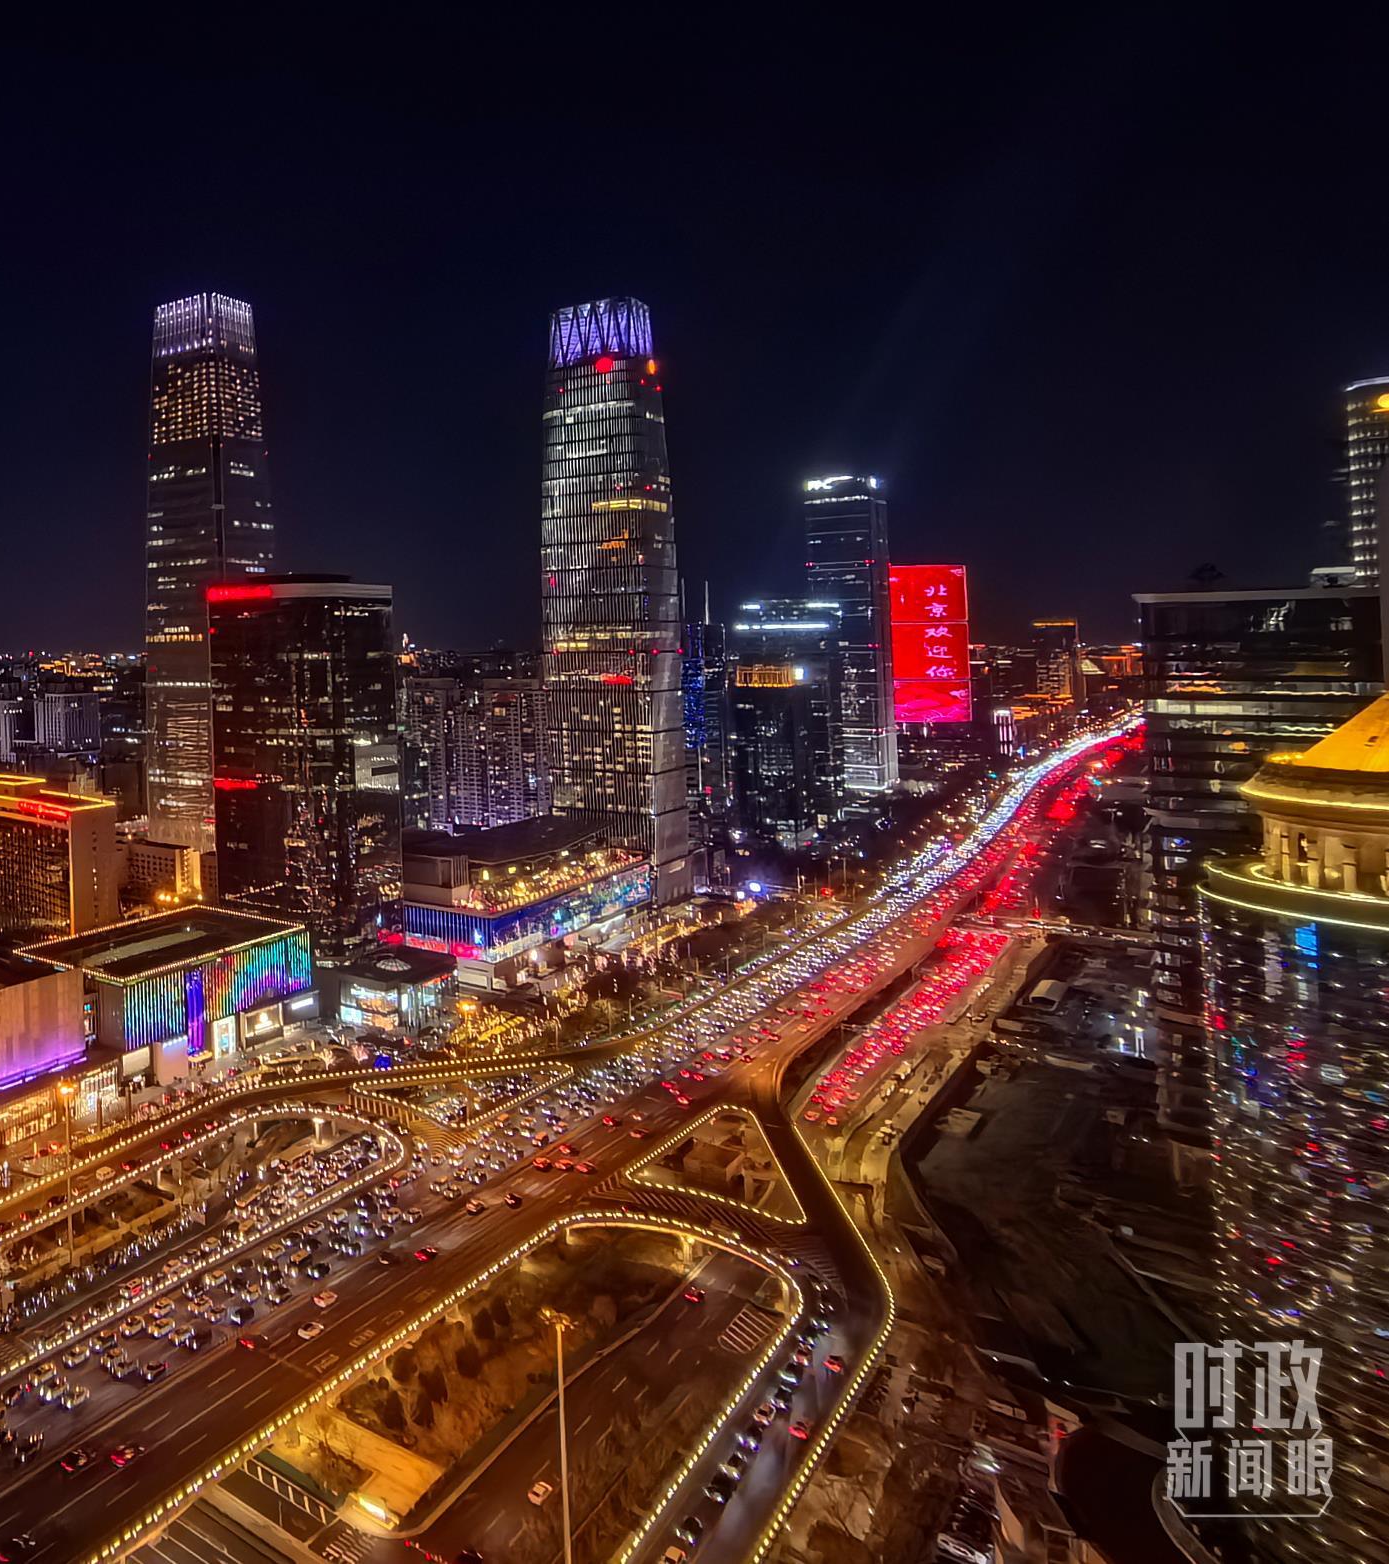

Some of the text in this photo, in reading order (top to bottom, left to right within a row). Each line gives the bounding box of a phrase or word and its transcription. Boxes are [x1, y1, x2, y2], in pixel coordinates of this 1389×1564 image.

[924, 584, 954, 678] 北京欢迎你
